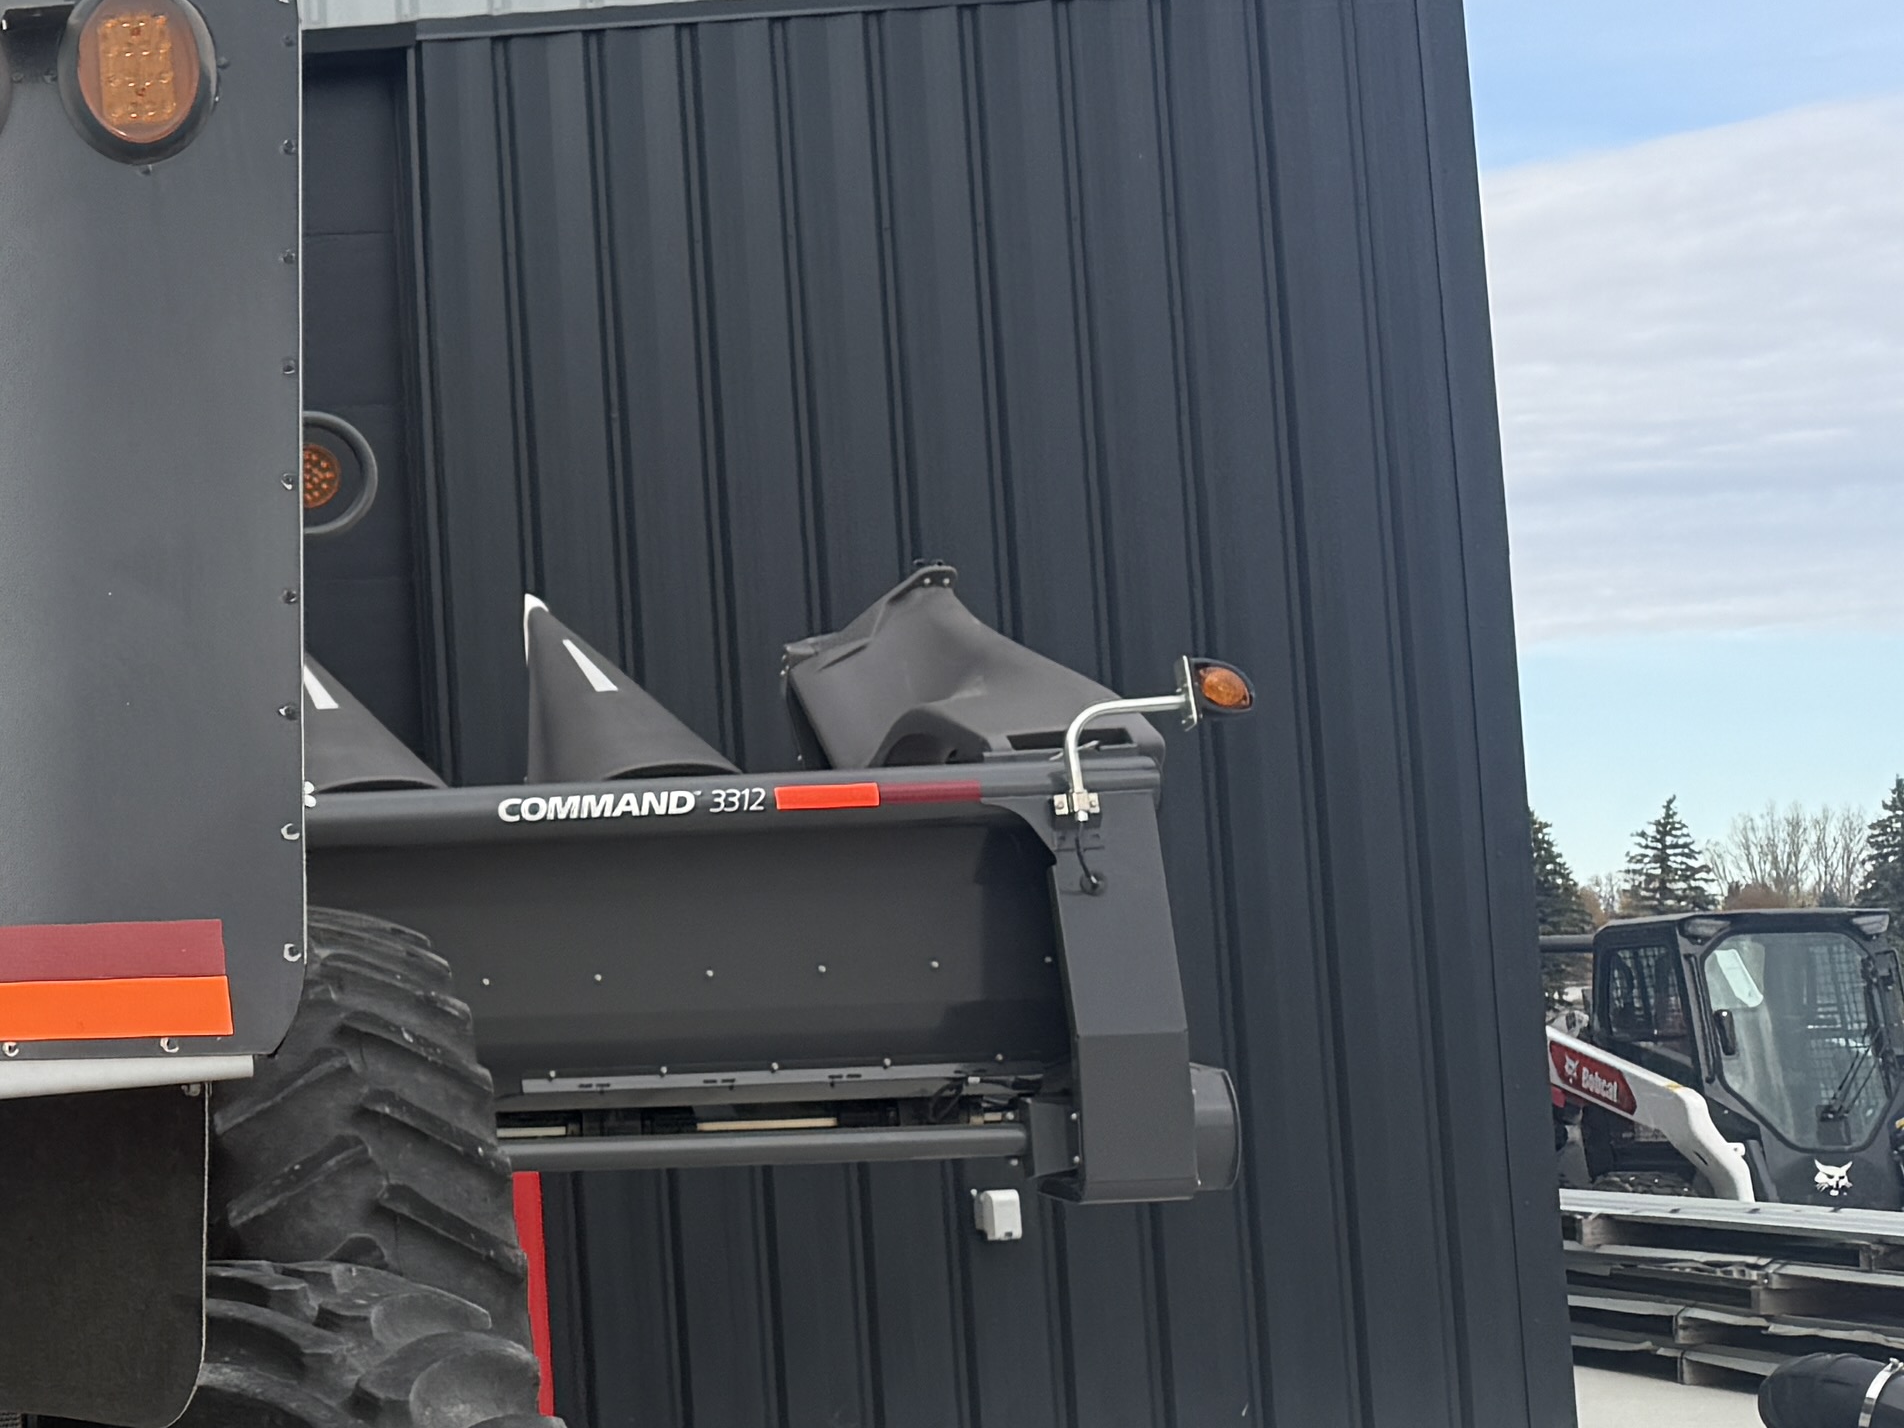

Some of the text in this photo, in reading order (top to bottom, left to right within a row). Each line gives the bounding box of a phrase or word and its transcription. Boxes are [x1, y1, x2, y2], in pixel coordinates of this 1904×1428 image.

[497, 787, 766, 822] COMMAND 3312
[1581, 1066, 1618, 1103] Bobcat
